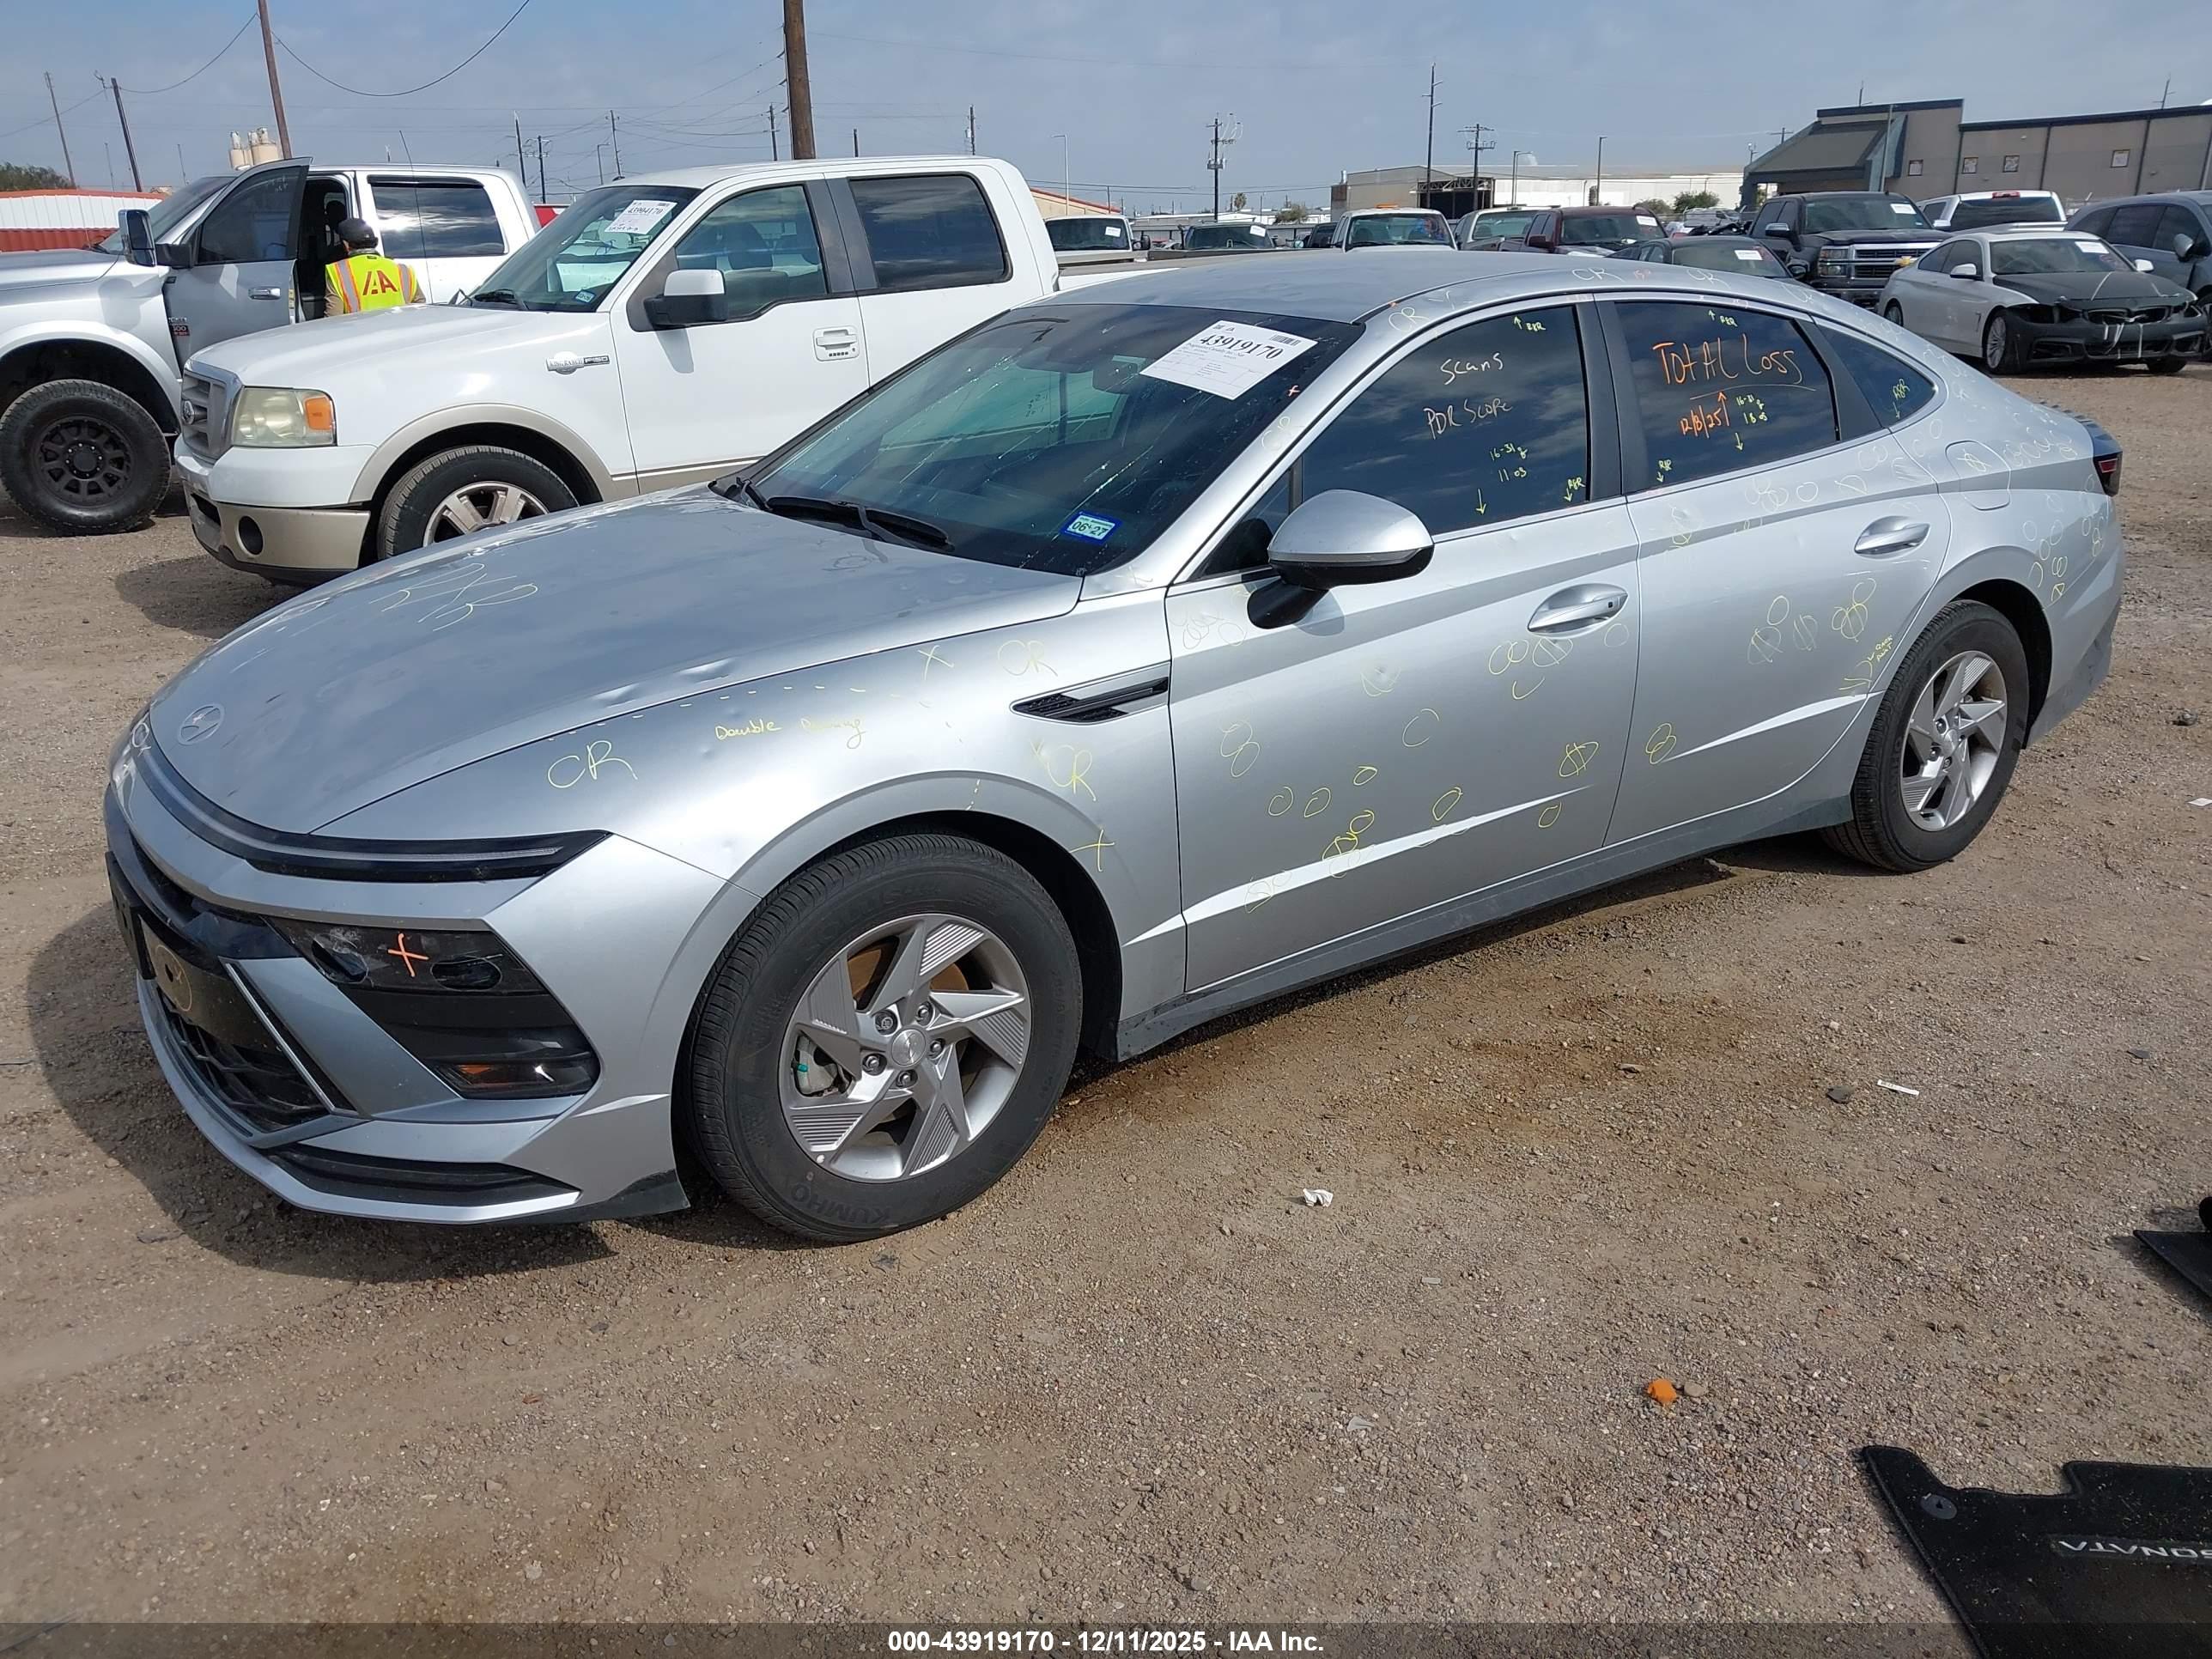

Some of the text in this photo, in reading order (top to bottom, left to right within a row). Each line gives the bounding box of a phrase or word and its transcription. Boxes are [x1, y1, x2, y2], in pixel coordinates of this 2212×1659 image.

[1199, 333, 1285, 360] 43919170
[1424, 404, 1463, 441] PDR
[548, 740, 638, 788] CR
